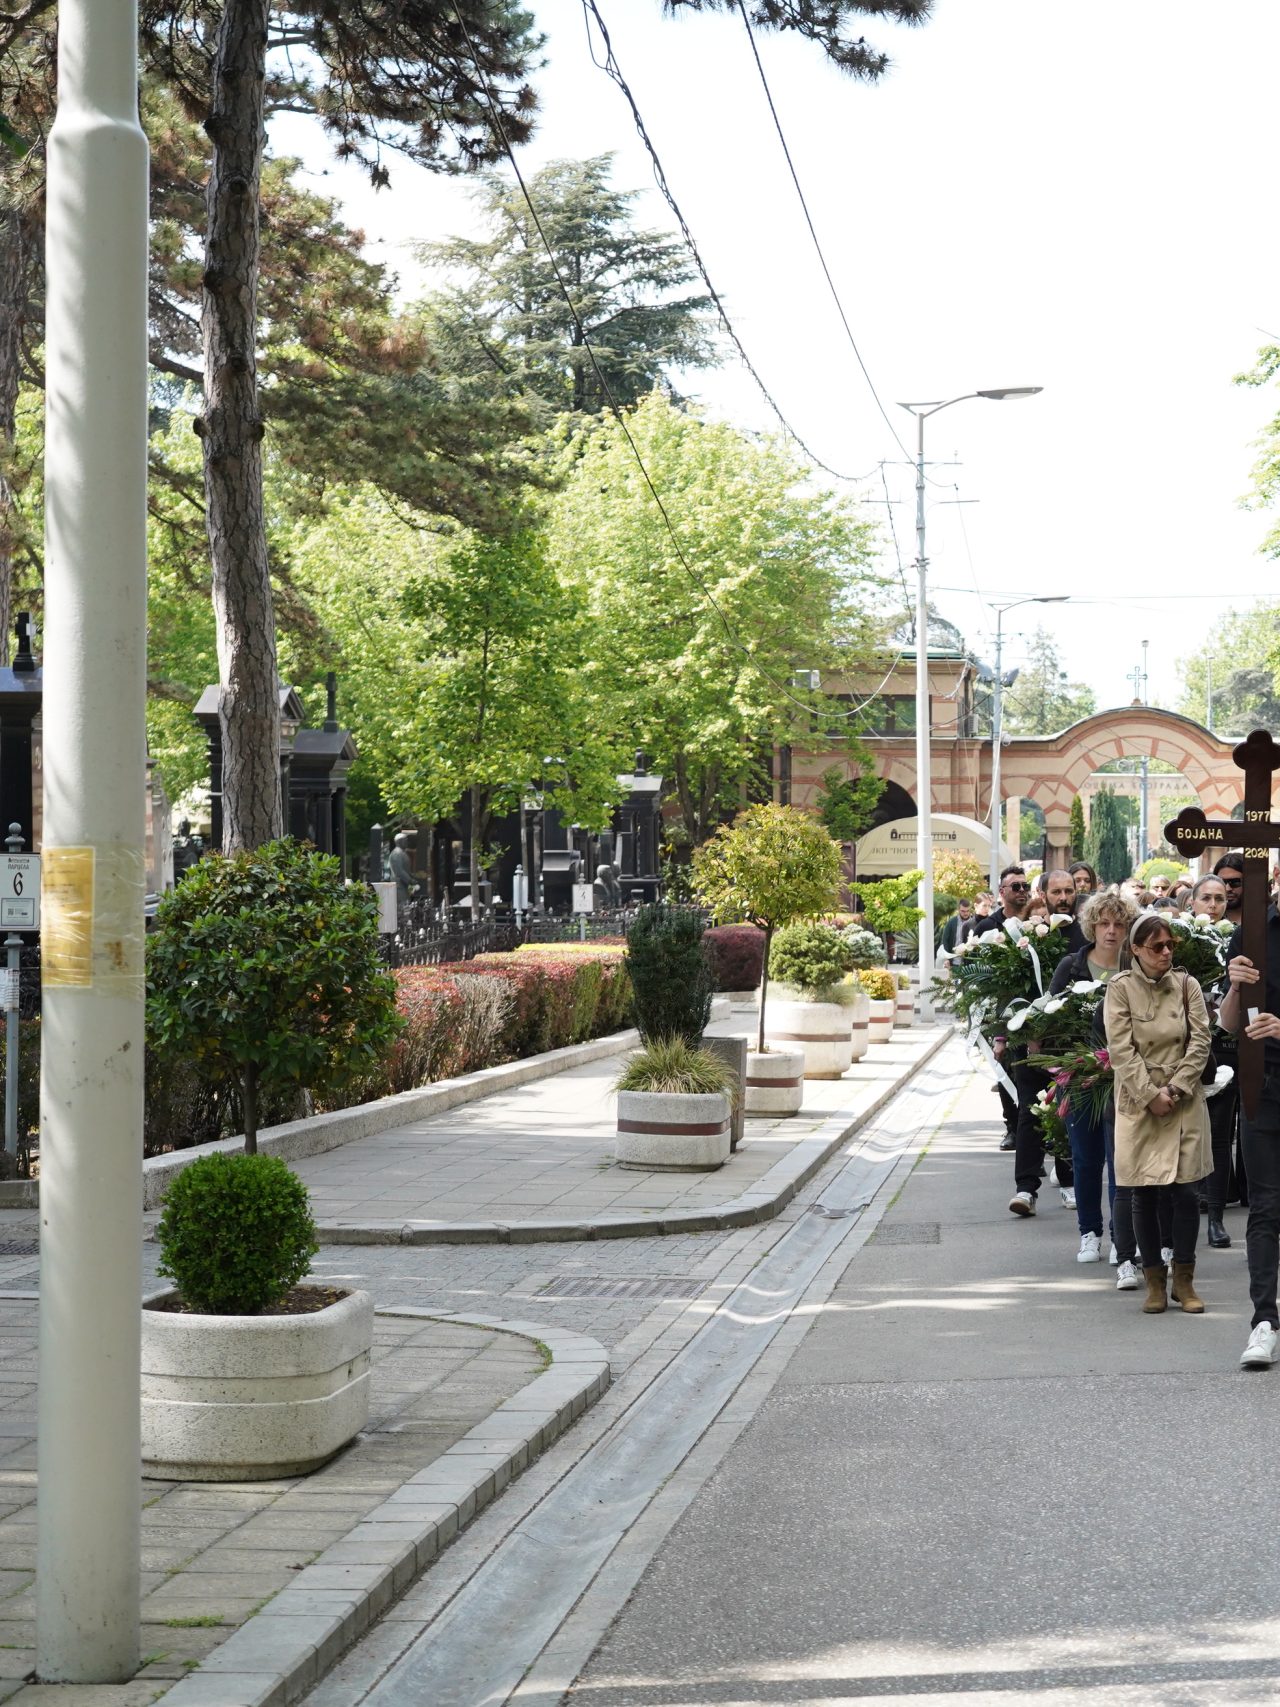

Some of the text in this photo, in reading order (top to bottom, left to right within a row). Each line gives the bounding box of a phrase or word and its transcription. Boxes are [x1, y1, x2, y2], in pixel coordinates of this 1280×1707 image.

[1245, 811, 1270, 822] 1977
[1177, 828, 1224, 840] БОЈАНА
[1244, 847, 1269, 859] 2024
[13, 872, 24, 896] 6
